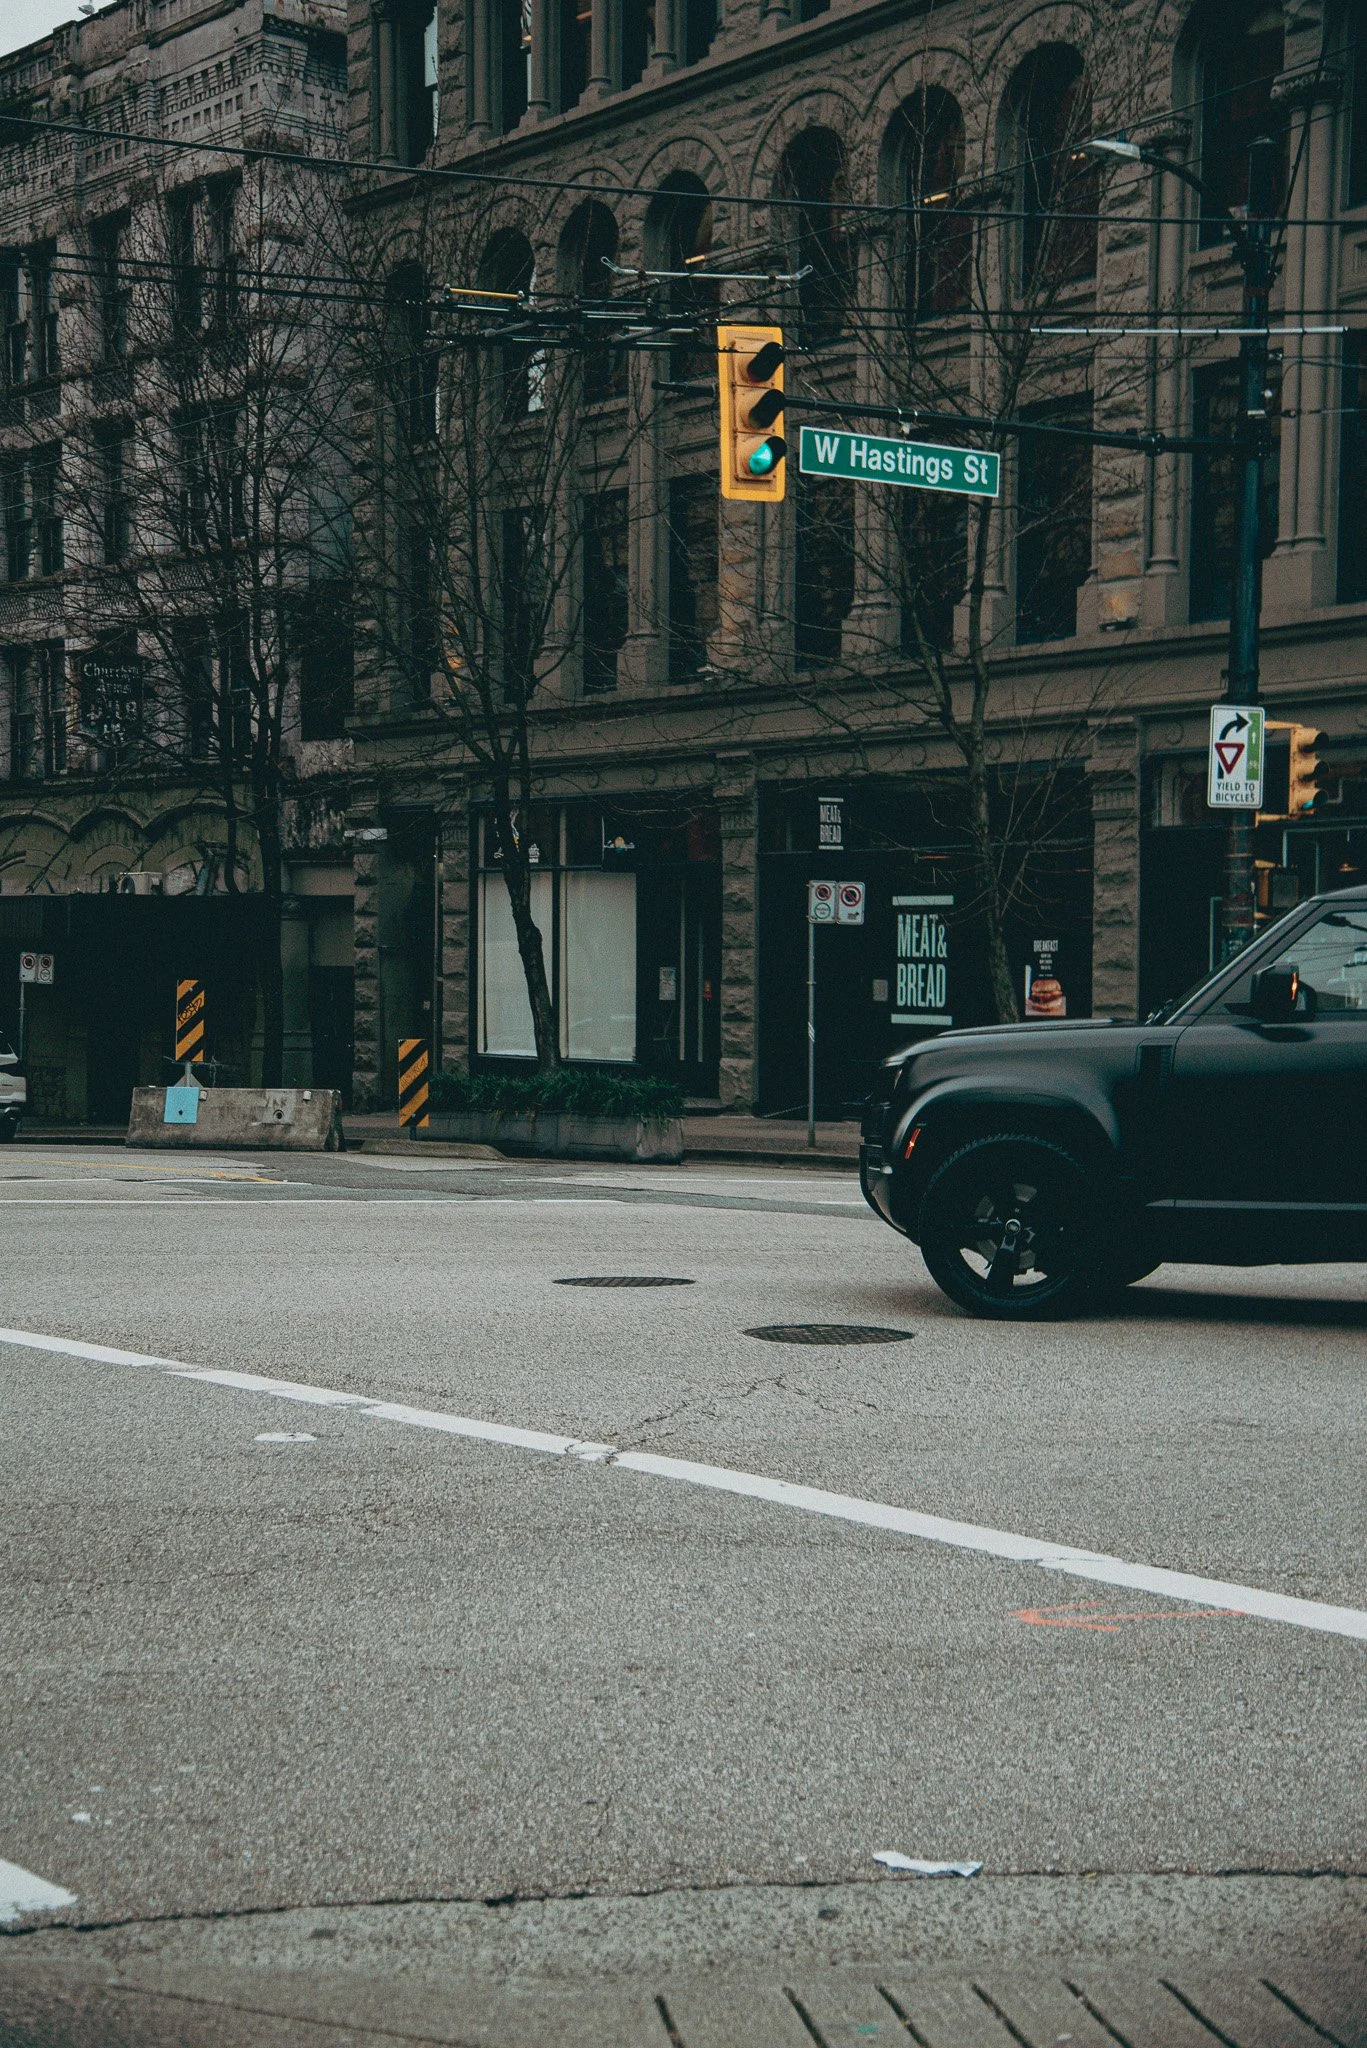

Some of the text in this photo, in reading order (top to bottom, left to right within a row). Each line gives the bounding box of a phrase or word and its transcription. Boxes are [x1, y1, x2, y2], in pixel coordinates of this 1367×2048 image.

[814, 434, 989, 485] W Hastings St
[1217, 782, 1255, 791] YIELD TO
[1215, 792, 1255, 803] BICYCLES
[820, 824, 842, 843] BREAD
[1033, 939, 1059, 953] BREAKFAST
[896, 963, 946, 1008] BREAD
